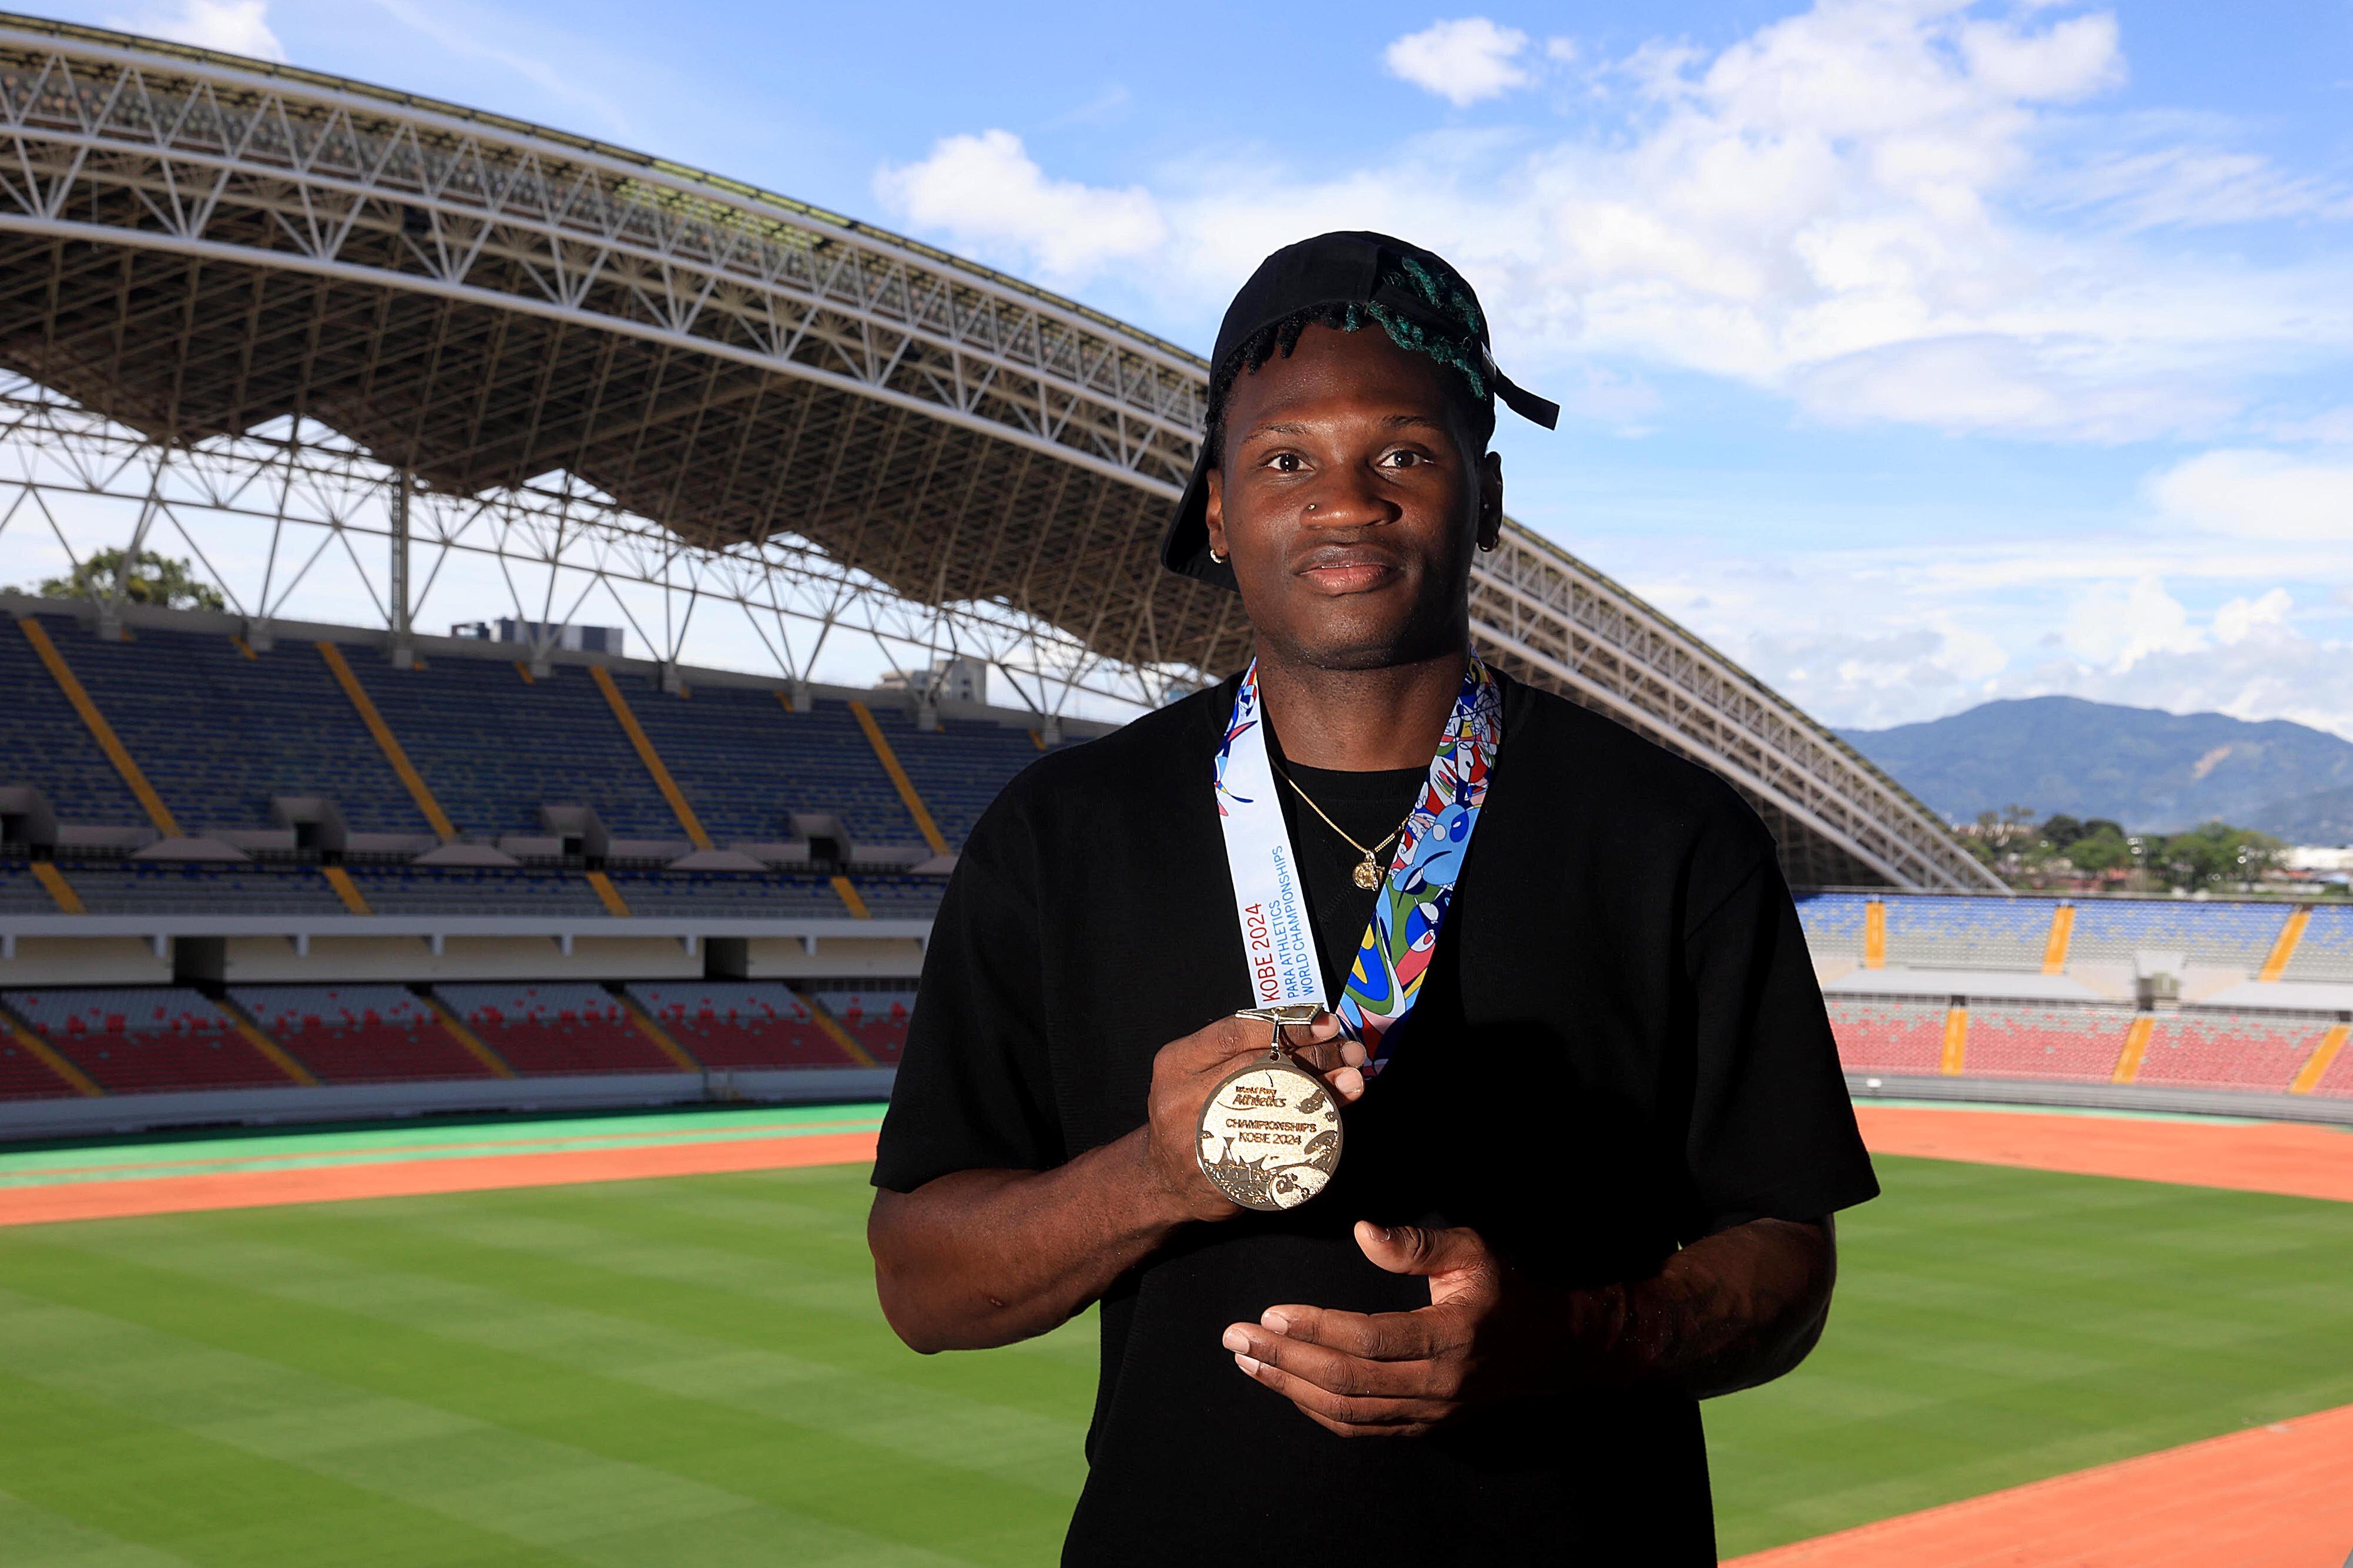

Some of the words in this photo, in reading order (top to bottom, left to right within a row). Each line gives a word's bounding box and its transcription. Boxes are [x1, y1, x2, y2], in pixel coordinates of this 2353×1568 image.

[1272, 845, 1304, 953] CHAMPIONSHIPS
[1245, 903, 1271, 950] 2024
[1269, 900, 1293, 968] ATHLETICS
[1255, 953, 1281, 1002] KOBE
[1282, 968, 1299, 999] PARA
[1296, 953, 1314, 996] WORLD
[1232, 1094, 1287, 1108] Athletics
[1225, 1118, 1317, 1132] CHAMPIONSHIPS
[1239, 1132, 1271, 1144] KOBE
[1272, 1133, 1302, 1145] 2024
